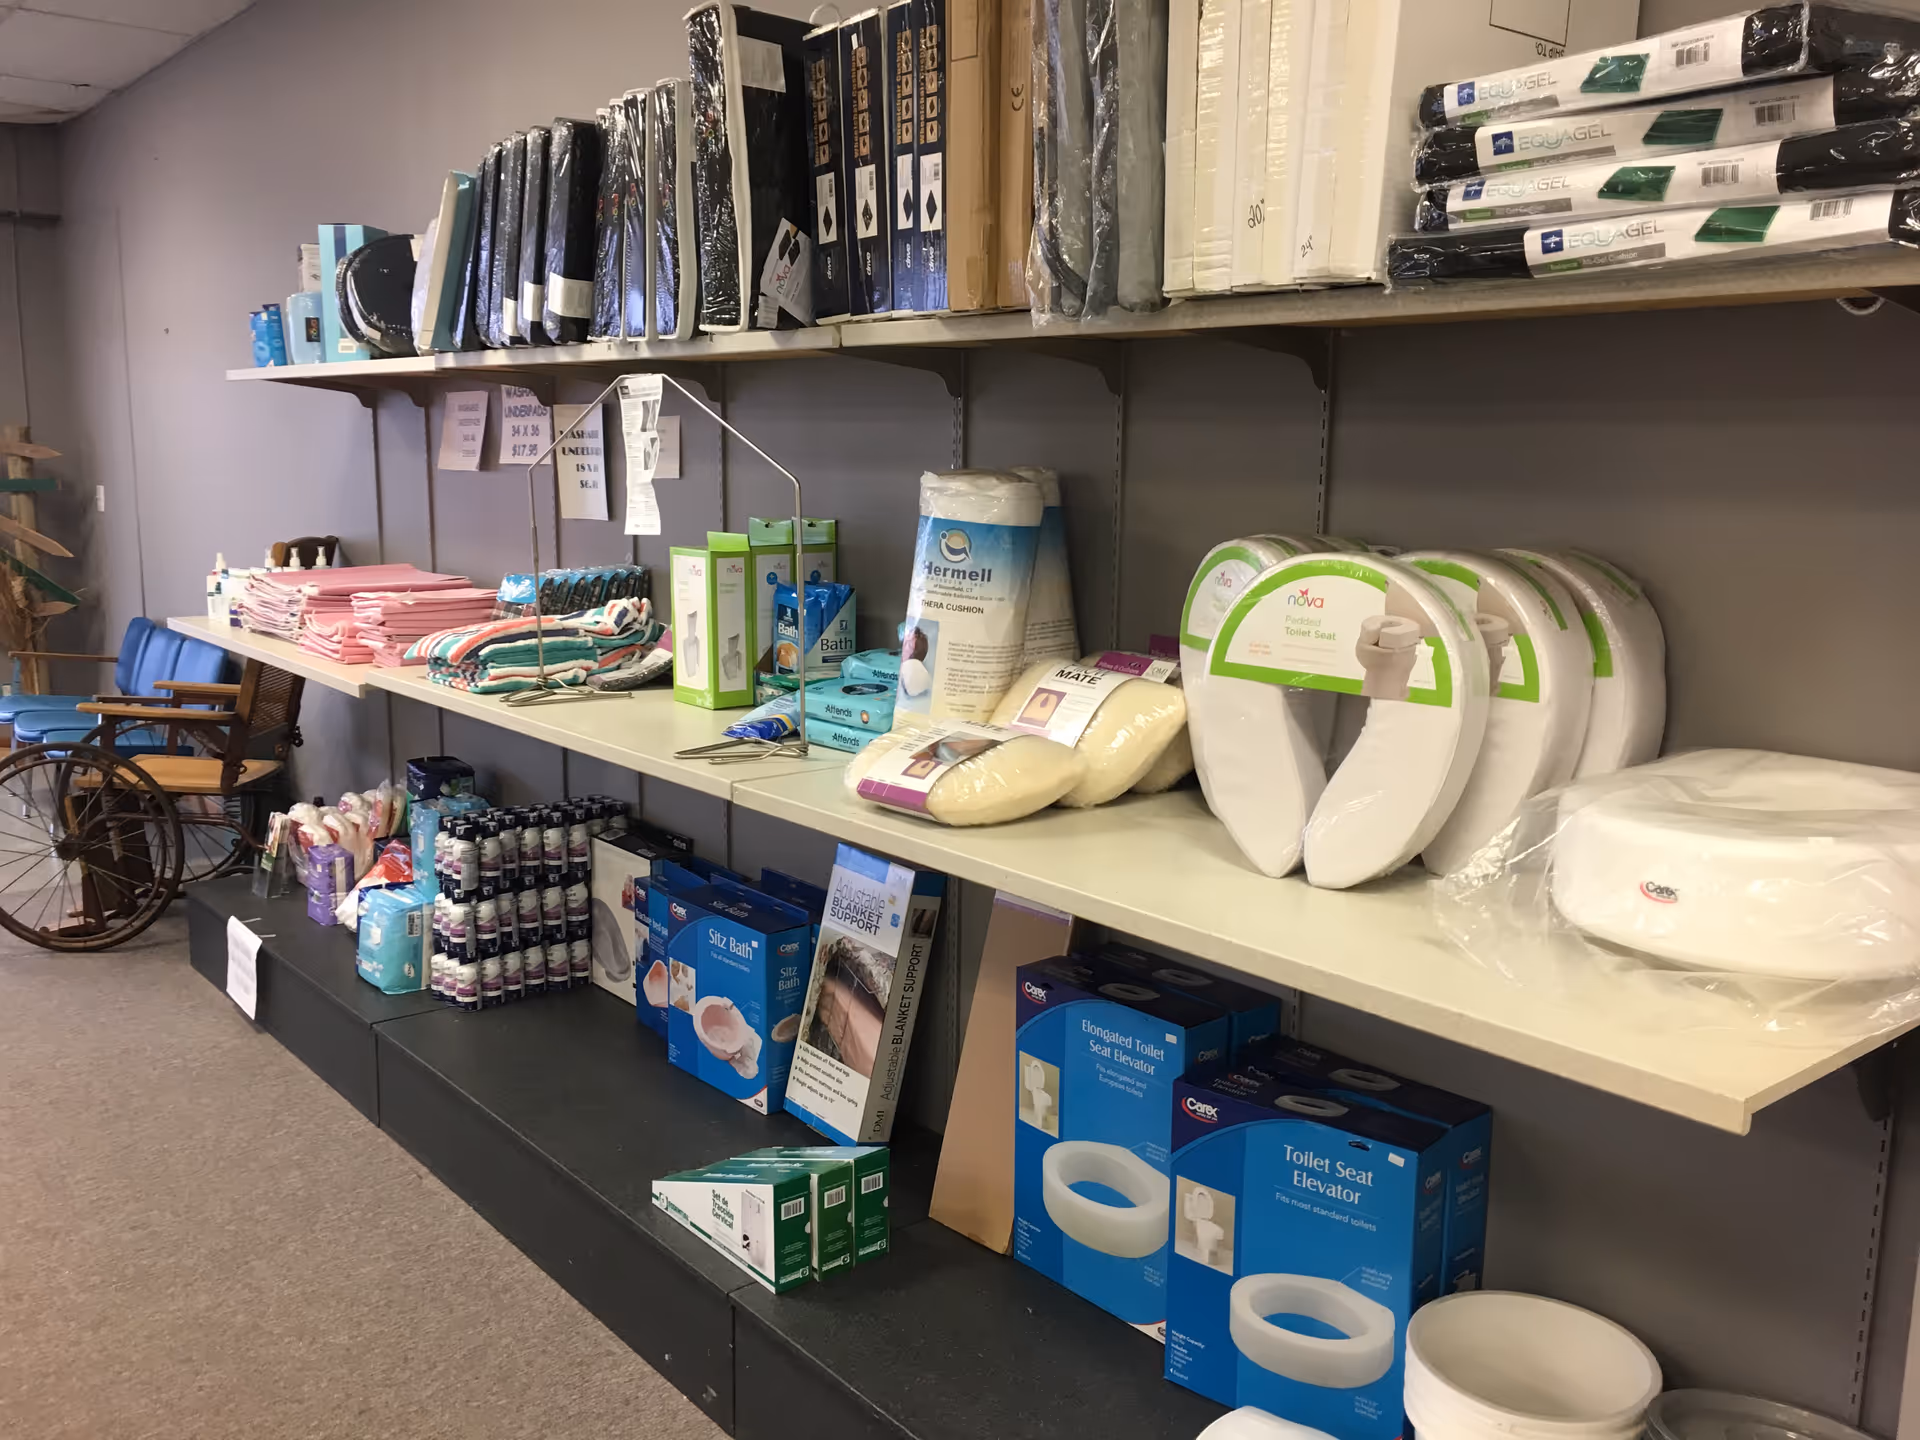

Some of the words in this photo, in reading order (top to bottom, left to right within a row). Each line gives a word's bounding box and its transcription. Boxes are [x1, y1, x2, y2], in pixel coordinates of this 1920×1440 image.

[1518, 123, 1612, 151] EQUAGEL
[1486, 175, 1571, 198] EQUAGEL
[1568, 219, 1665, 249] EQUAGEL
[776, 264, 792, 295] nova
[504, 404, 549, 419] UNDERPADS
[511, 424, 521, 438] 34
[522, 424, 529, 437] X
[530, 423, 540, 437] 36
[922, 560, 993, 583] Hermell
[1214, 575, 1233, 588] nova
[921, 599, 944, 610] THERA
[945, 603, 985, 615] CUSHION
[1287, 591, 1325, 609] nova
[777, 622, 799, 639] Bath
[1284, 614, 1322, 628] Padded
[820, 637, 853, 652] Bath
[1284, 626, 1312, 638] Toilet
[1313, 628, 1337, 642] Seat
[873, 669, 899, 681] Attends
[1055, 669, 1103, 686] MATE
[826, 704, 853, 718] Attends
[833, 732, 860, 747] Attends
[834, 876, 886, 916] Adjustable
[1645, 880, 1679, 897] Carex
[672, 902, 687, 916] Carex
[832, 895, 883, 925] BLANKET
[829, 906, 881, 936] SUPPORT
[708, 928, 727, 950] Sitz
[729, 936, 753, 961] Bath
[780, 966, 798, 979] Sitz
[778, 976, 800, 991] Bath
[1024, 981, 1047, 999] Carex
[872, 1110, 886, 1134] DMI
[880, 1046, 902, 1101] Adjustable
[891, 994, 912, 1046] BLANKET
[904, 943, 925, 993] SUPPORT
[1081, 1018, 1133, 1050] Elongated
[1134, 1038, 1165, 1062] Toilet
[1089, 1039, 1112, 1059] Seat
[1113, 1048, 1156, 1076] Elevator
[1186, 1097, 1219, 1118] Carex
[1283, 1144, 1331, 1174] Toilet
[1335, 1160, 1375, 1188] Seat
[1293, 1169, 1362, 1205] Elevator
[711, 1188, 722, 1203] Set
[721, 1196, 729, 1209] de
[711, 1197, 735, 1222] Tracción
[711, 1207, 735, 1231] Cervical
[1275, 1191, 1291, 1205] Fits
[1290, 1199, 1312, 1212] most
[1312, 1205, 1350, 1225] standard
[1350, 1217, 1378, 1233] toilets
